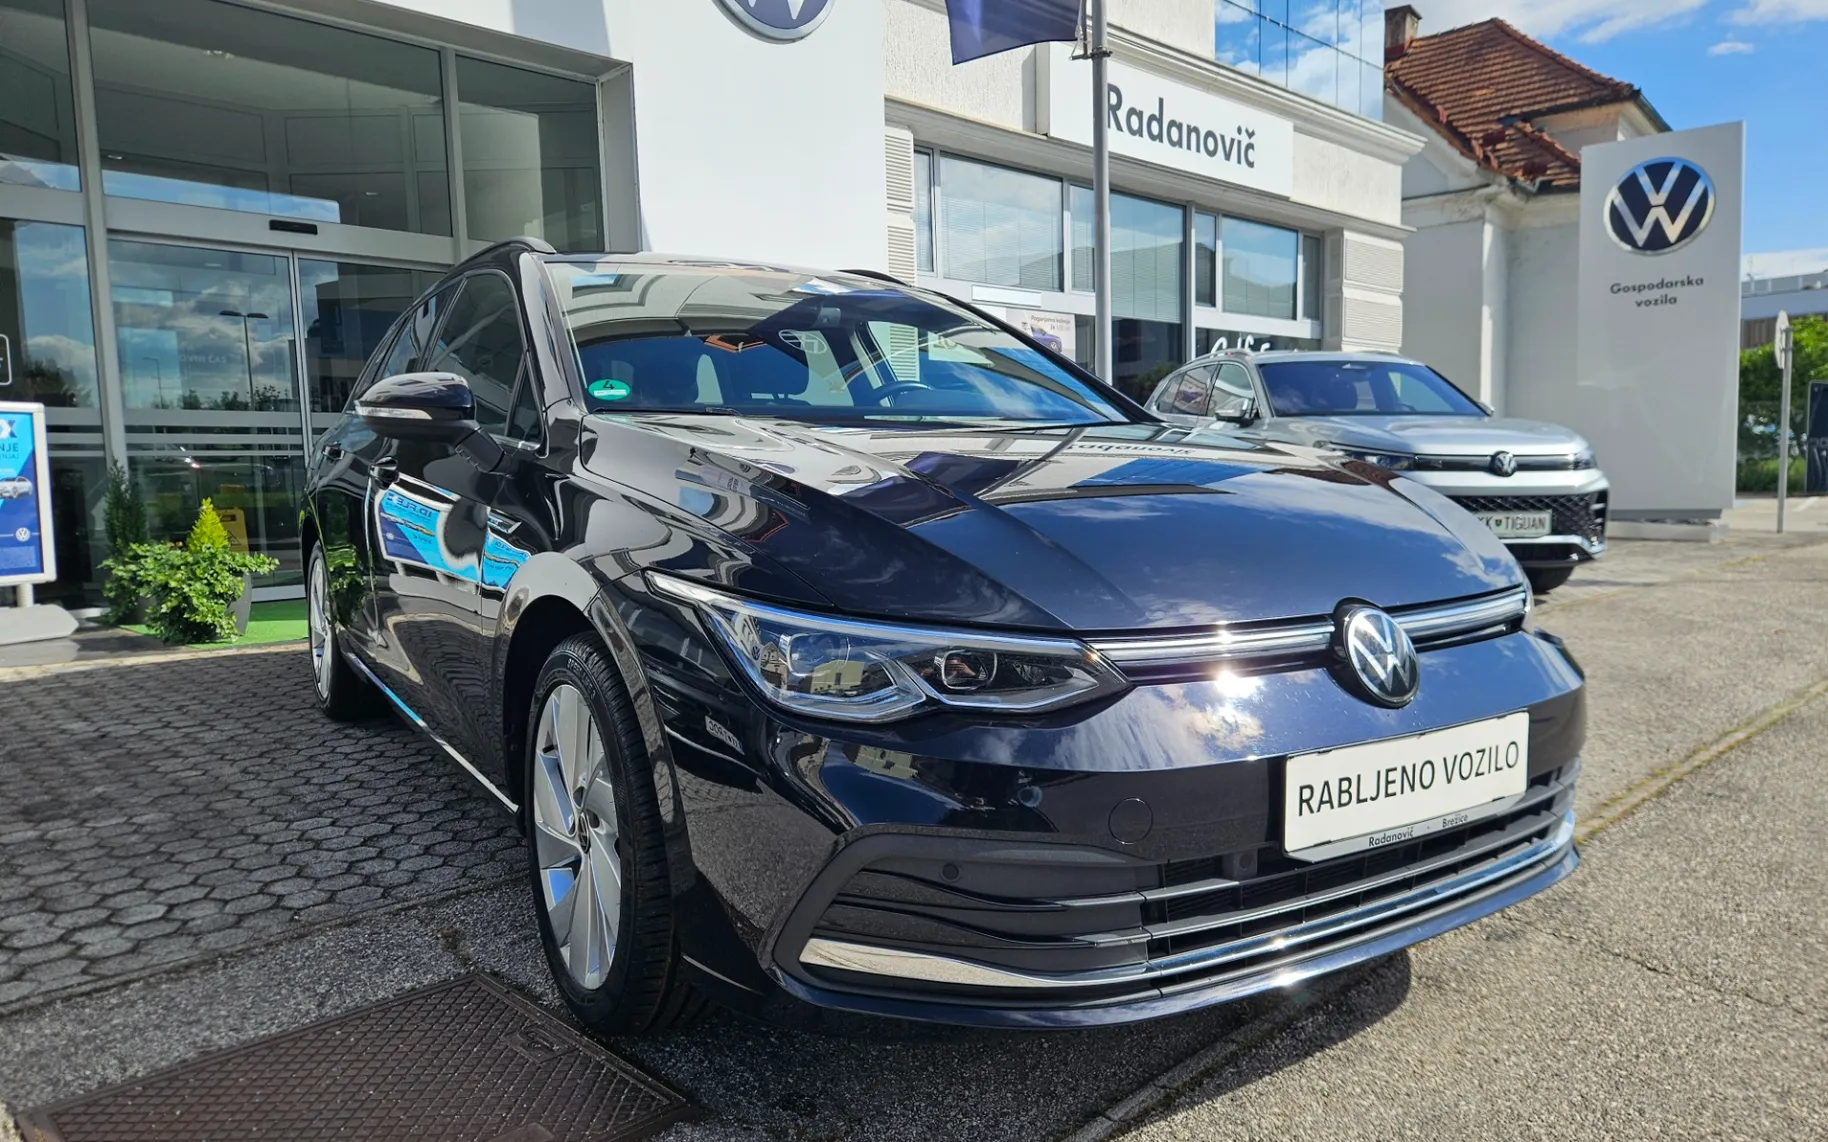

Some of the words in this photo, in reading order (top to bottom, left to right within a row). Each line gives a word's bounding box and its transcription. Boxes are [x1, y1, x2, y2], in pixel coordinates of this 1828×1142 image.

[1107, 83, 1256, 169] Radanovič
[1610, 274, 1704, 295] Gospodarska
[1635, 293, 1678, 308] vozila
[1504, 515, 1547, 531] TIGUAN
[1297, 760, 1436, 817] RABLJENO
[1442, 740, 1520, 785] VOZILO
[1368, 826, 1415, 847] Radanovič
[1442, 812, 1469, 828] Brežice
